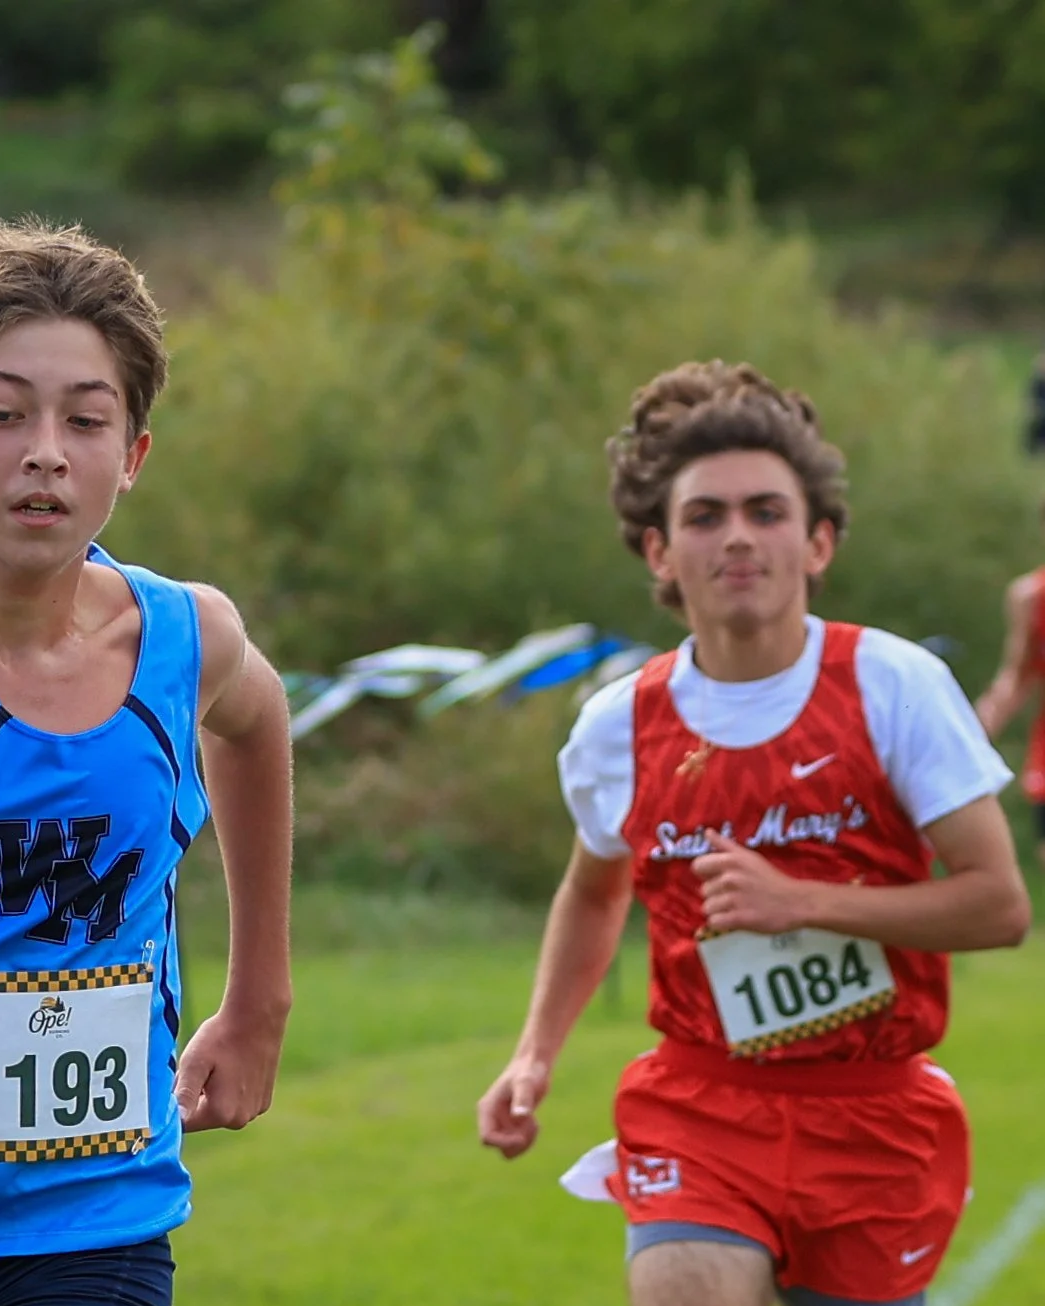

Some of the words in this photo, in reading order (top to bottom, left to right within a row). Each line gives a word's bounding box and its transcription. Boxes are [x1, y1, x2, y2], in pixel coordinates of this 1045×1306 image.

[745, 795, 869, 849] Mary's
[733, 940, 872, 1027] 1084
[28, 1006, 73, 1037] Ope!
